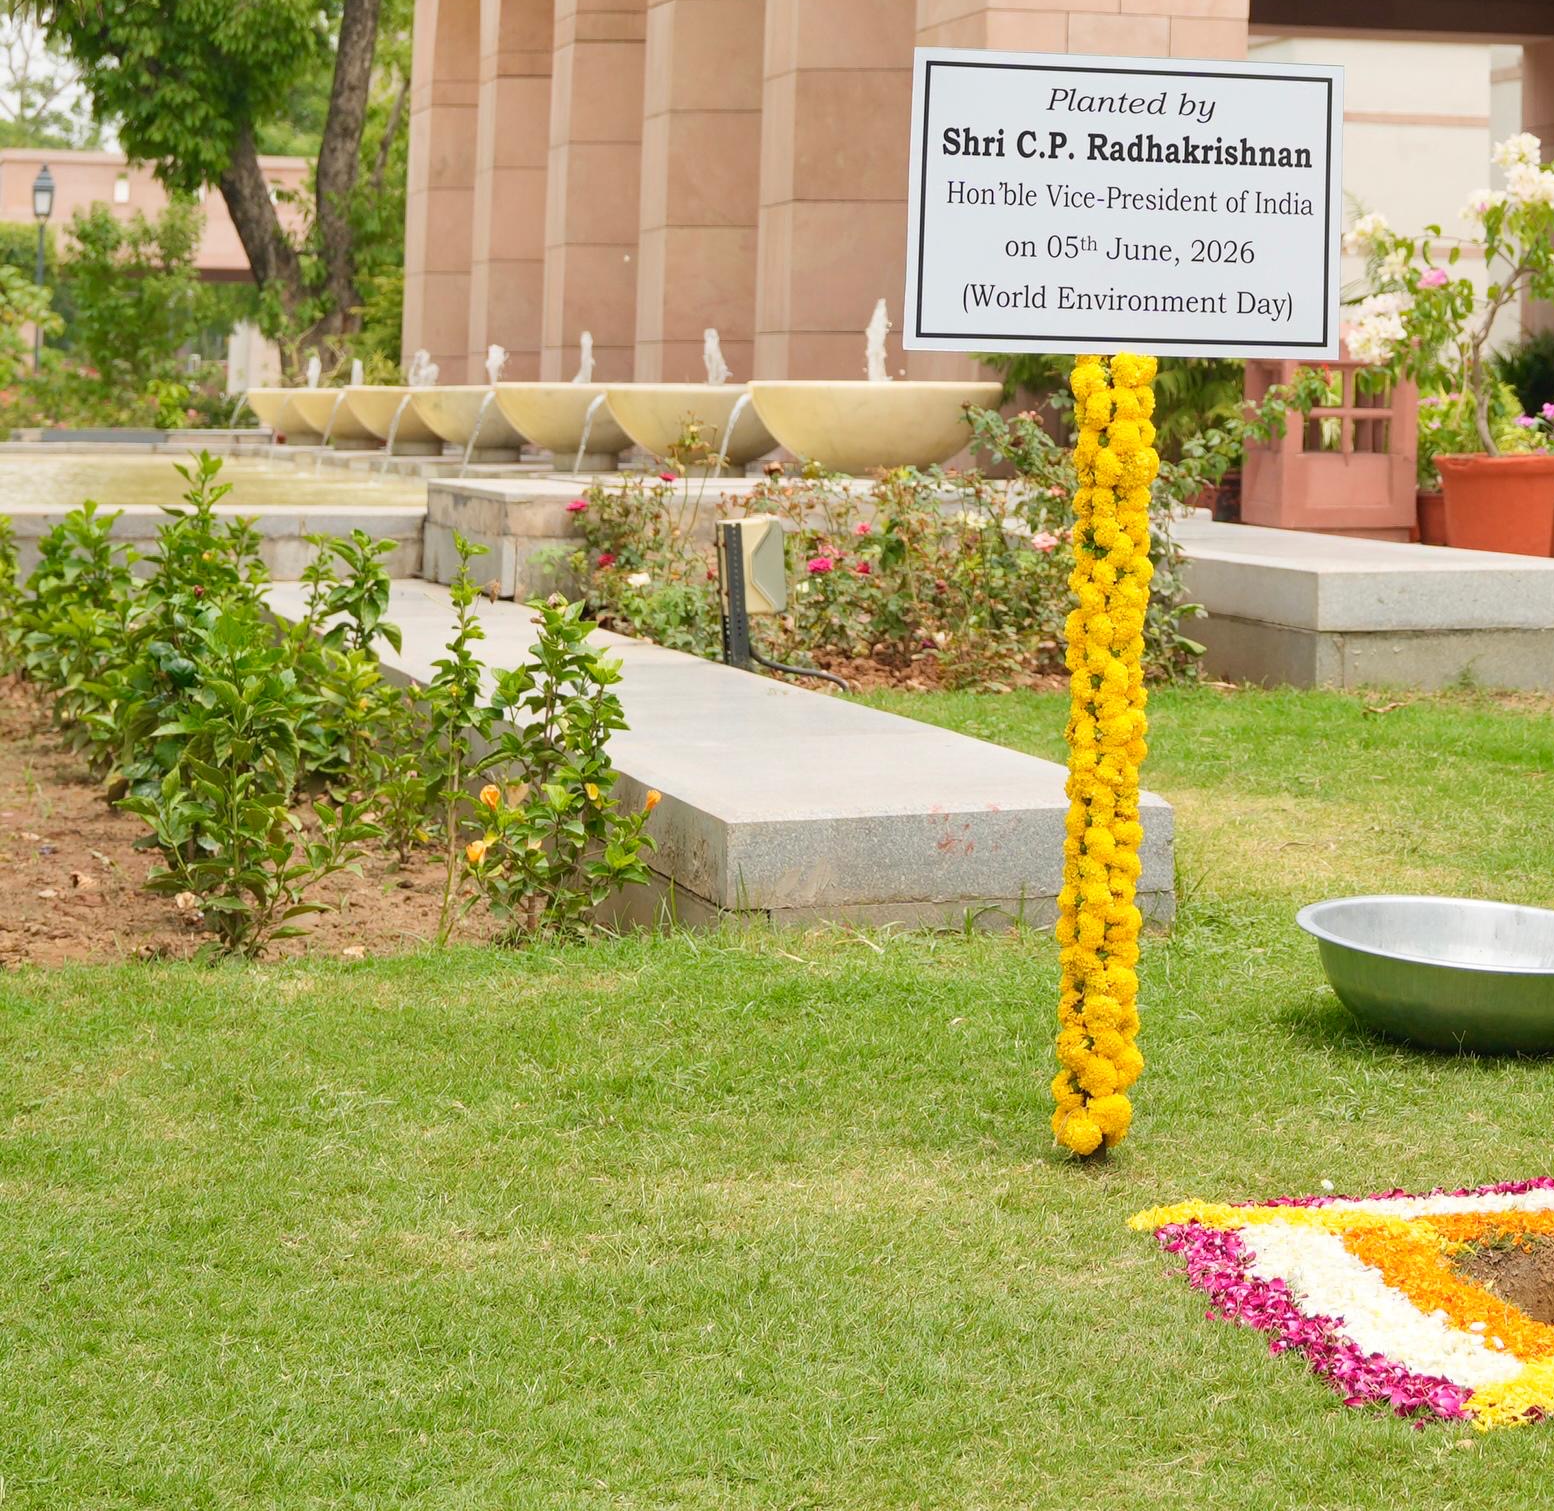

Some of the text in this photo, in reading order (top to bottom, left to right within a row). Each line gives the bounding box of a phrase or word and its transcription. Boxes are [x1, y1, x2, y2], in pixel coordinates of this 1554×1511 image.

[1045, 87, 1216, 124] Planted by
[942, 126, 1313, 169] Shri C.P. Radhakrishnan
[1045, 184, 1218, 213] Vice-President
[1225, 189, 1250, 214] of
[1255, 191, 1314, 216] India
[1005, 234, 1255, 267] on 05th June, 2026
[963, 283, 1293, 322] (World Environment Day)
